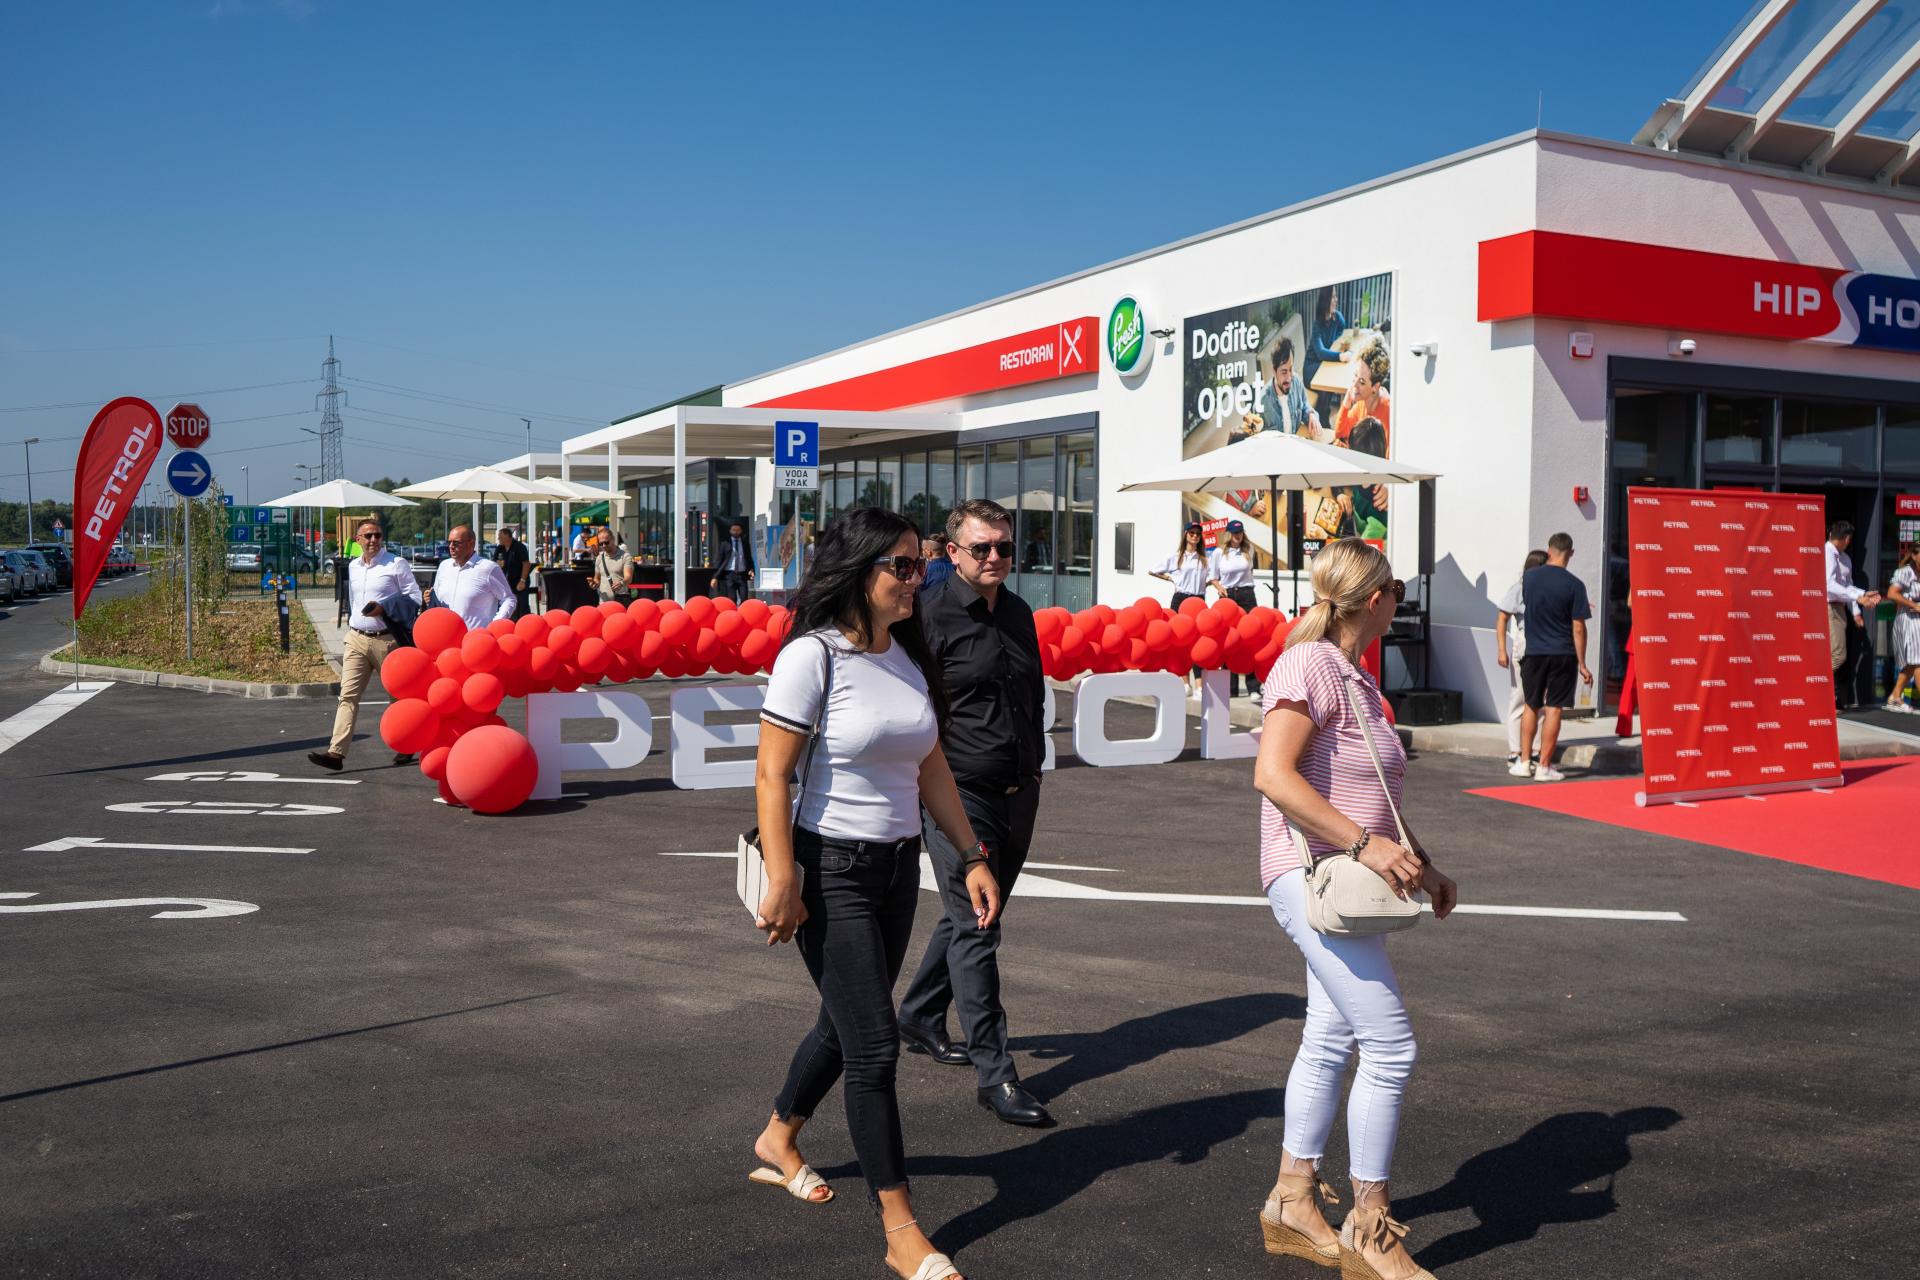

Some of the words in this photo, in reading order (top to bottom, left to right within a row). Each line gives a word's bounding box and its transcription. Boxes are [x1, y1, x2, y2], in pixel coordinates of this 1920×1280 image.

[1754, 281, 1821, 317] HIP
[1113, 302, 1142, 367] fresh
[1192, 320, 1260, 360] Dođite
[1000, 342, 1054, 371] RESTORAN
[1216, 360, 1248, 380] nam
[1197, 371, 1265, 428] opet
[168, 416, 208, 436] STOP
[787, 429, 806, 457] P
[785, 469, 808, 478] VODA
[84, 422, 153, 541] PETROL
[785, 479, 808, 487] ZRAK
[1633, 498, 1660, 506] PETROL
[1690, 500, 1716, 508] PETROL
[1744, 502, 1769, 511] PETROL
[1796, 504, 1820, 512] PETROL
[1662, 521, 1689, 529] PETROL
[1720, 523, 1745, 531] PETROL
[1770, 524, 1795, 533] PETROL
[1634, 544, 1663, 552] PETROL
[1693, 544, 1720, 553] PETROL
[1747, 546, 1771, 554] PETROL
[1798, 547, 1821, 555] PETROL
[1664, 567, 1692, 575] PETROL
[1724, 567, 1748, 575] PETROL
[1773, 568, 1798, 576] PETROL
[1636, 590, 1665, 598] PETROL
[1695, 589, 1724, 597] PETROL
[1750, 589, 1773, 597] PETROL
[1667, 612, 1695, 620] PETROL
[1727, 611, 1750, 619] PETROL
[1775, 611, 1800, 619] PETROL
[1639, 636, 1668, 644] PETROL
[1698, 634, 1725, 642] PETROL
[1751, 633, 1776, 641] PETROL
[1669, 658, 1697, 666] PETROL
[1728, 656, 1752, 664] PETROL
[1777, 655, 1802, 663] PETROL
[1642, 682, 1670, 690] PETROL
[1700, 680, 1727, 688] PETROL
[1753, 678, 1778, 686] PETROL
[1729, 701, 1754, 709] PETROL
[1780, 698, 1805, 707] PETROL
[1673, 704, 1700, 712] PETROL
[1703, 725, 1729, 733] PETROL
[1756, 721, 1781, 730] PETROL
[1646, 728, 1673, 737] PETROL
[1731, 745, 1757, 754] PETROL
[1783, 742, 1808, 751] PETROL
[1675, 749, 1702, 758] PETROL
[1759, 765, 1785, 774] PETROL
[1649, 774, 1676, 783] PETROL
[1706, 770, 1732, 779] PETROL
